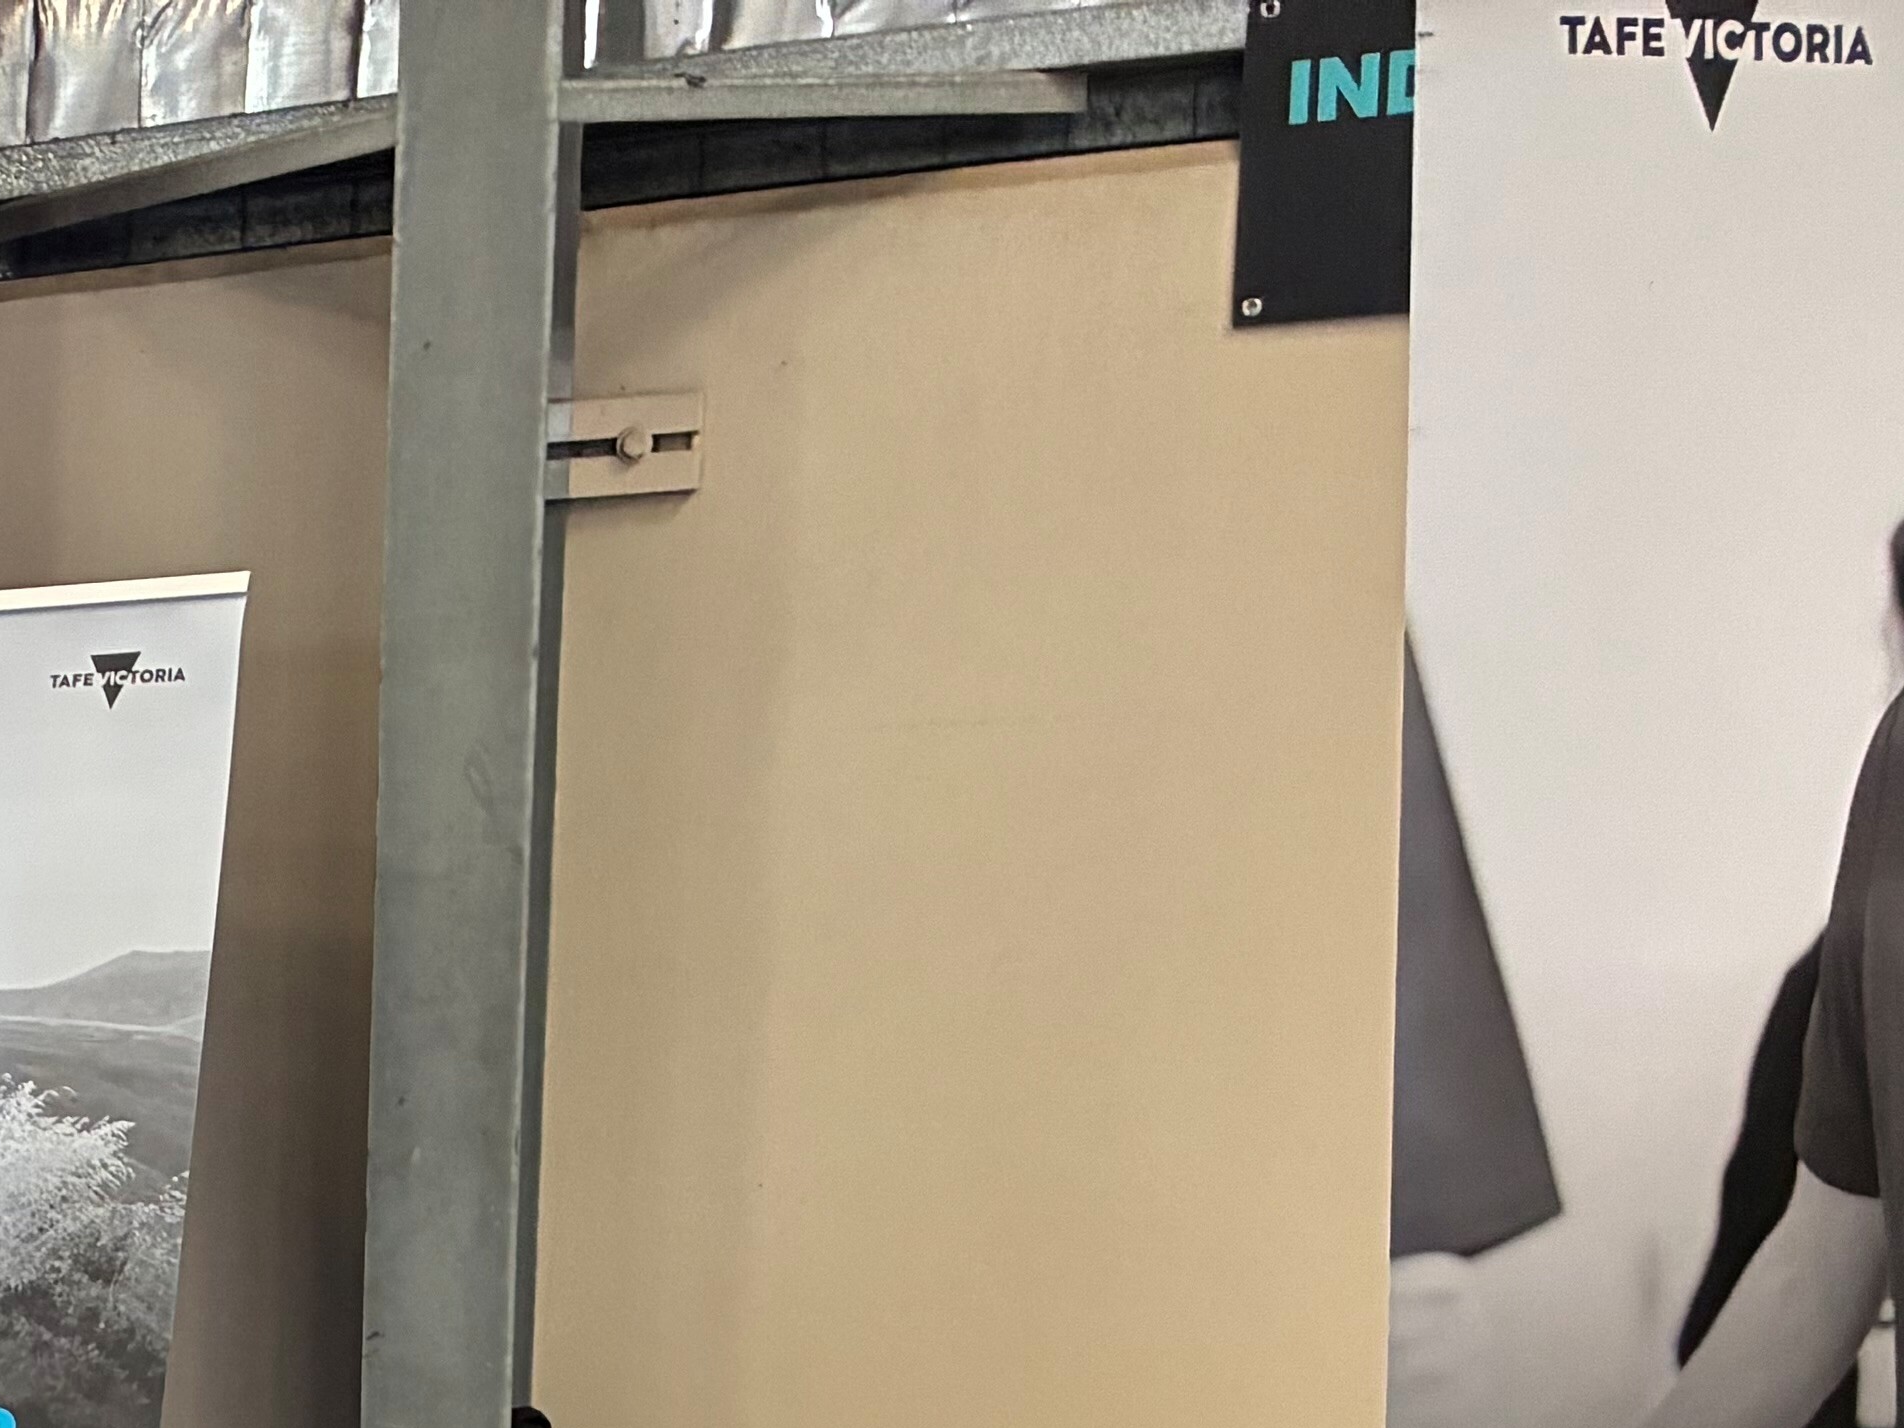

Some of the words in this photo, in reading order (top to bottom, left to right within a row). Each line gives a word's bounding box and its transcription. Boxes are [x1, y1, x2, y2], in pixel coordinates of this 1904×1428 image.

[1560, 15, 1666, 58] TAFE
[1680, 18, 1873, 65] VICTORIA
[50, 671, 94, 690] TAFE
[97, 666, 186, 688] VICTORIA
